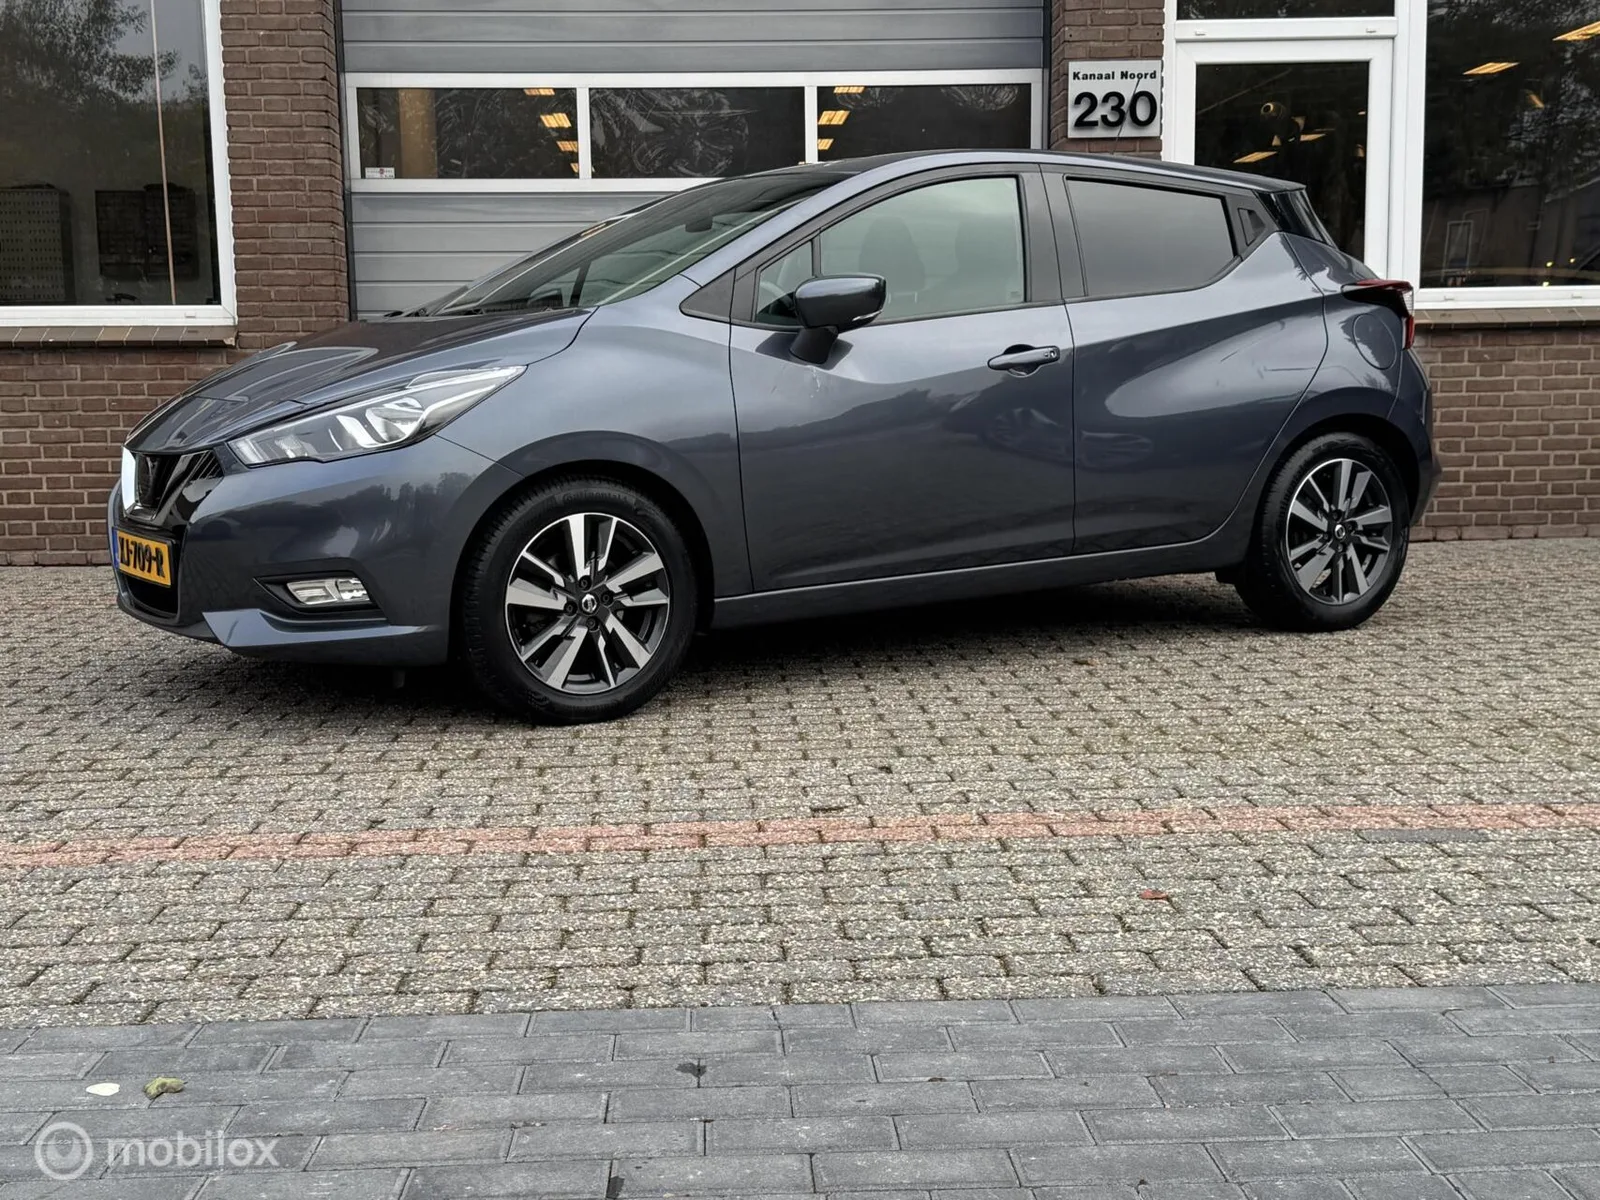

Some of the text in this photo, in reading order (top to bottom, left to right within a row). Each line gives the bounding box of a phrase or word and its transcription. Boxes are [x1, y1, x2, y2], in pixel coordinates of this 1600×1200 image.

[1072, 70, 1157, 80] Kanaal Noord
[1074, 90, 1157, 127] 230
